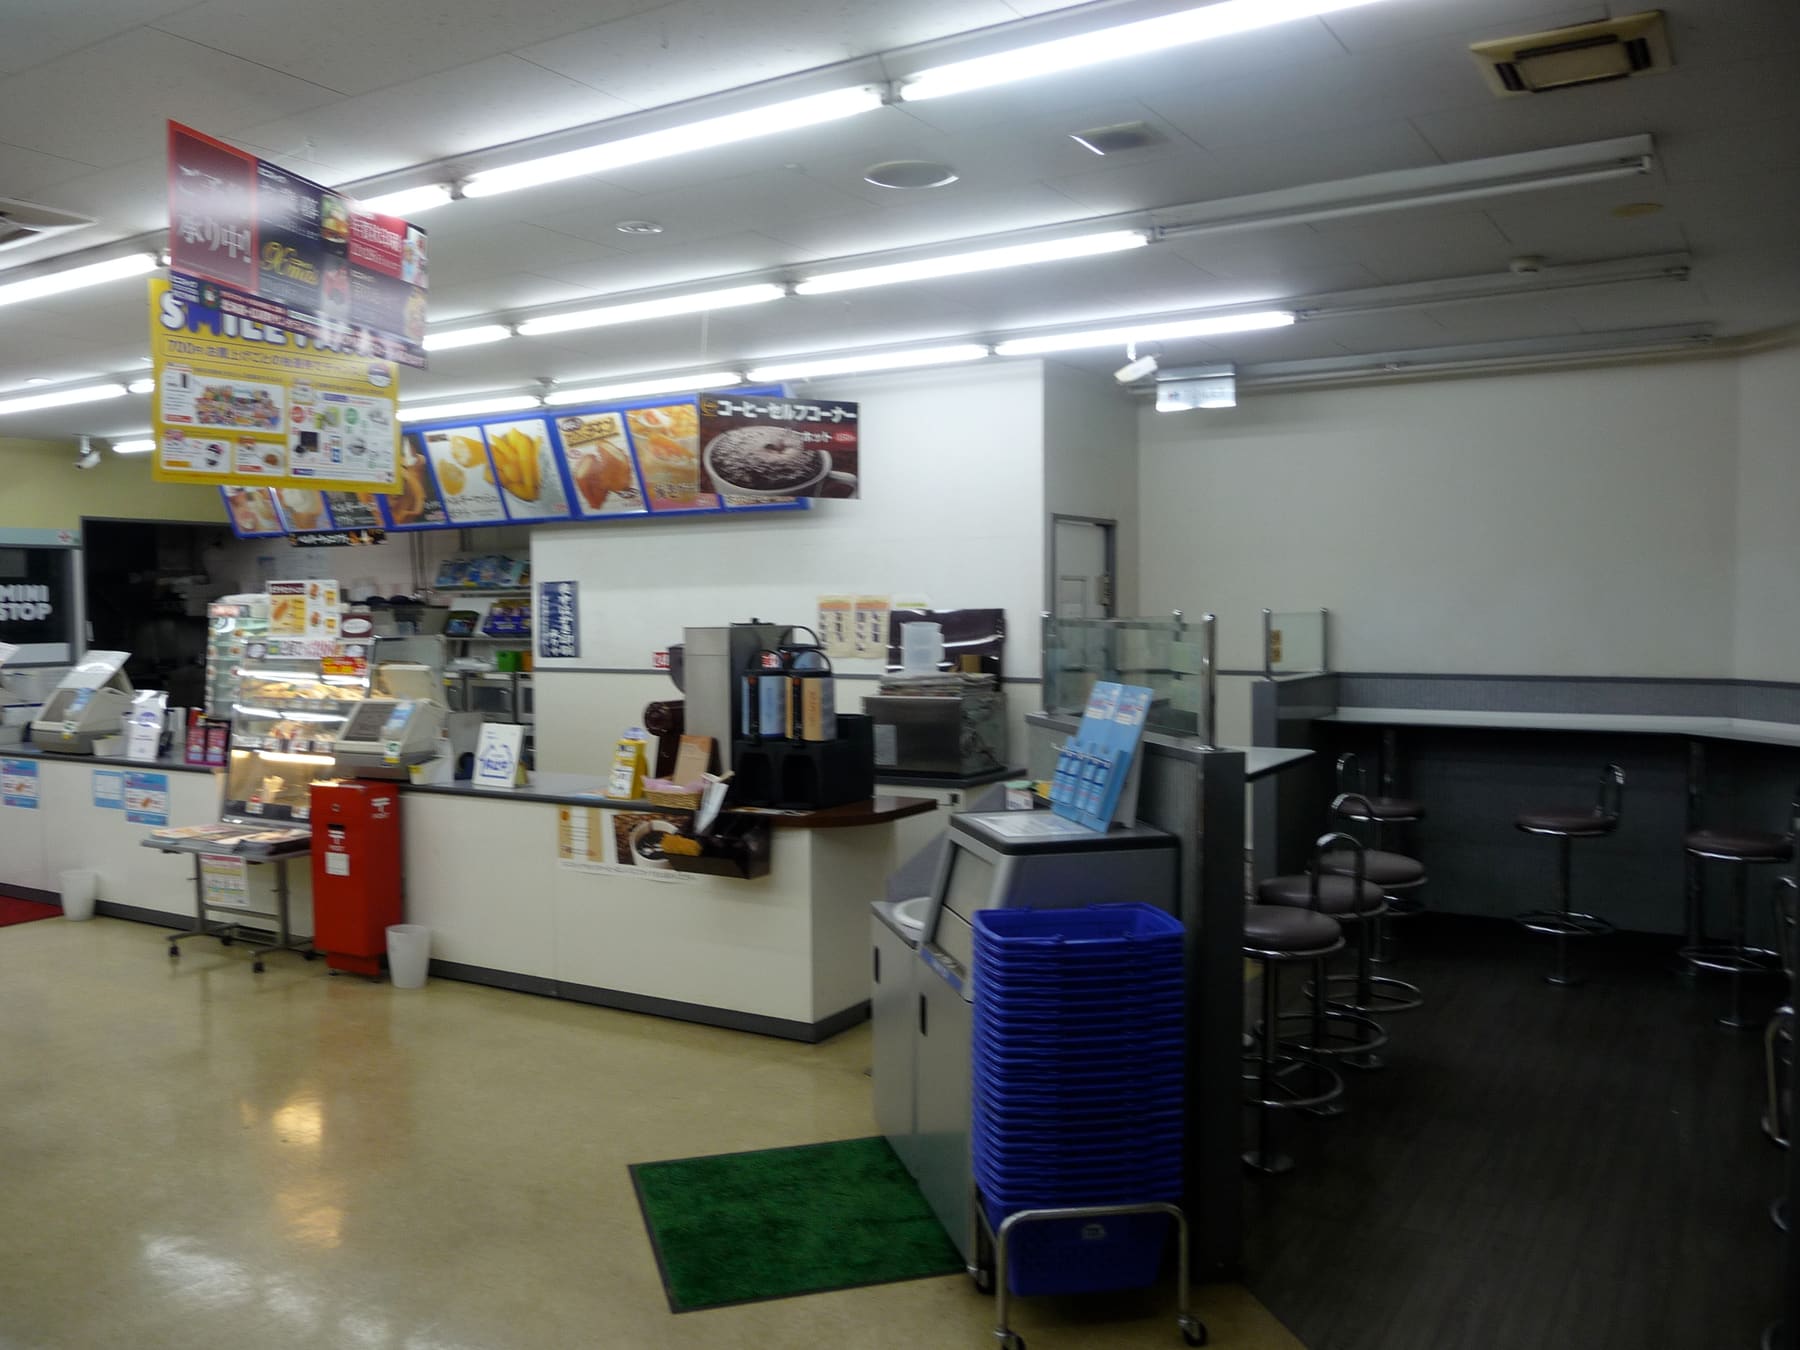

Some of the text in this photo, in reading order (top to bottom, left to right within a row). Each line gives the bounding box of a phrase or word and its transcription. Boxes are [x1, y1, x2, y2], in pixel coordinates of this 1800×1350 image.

[716, 400, 858, 423] コーヒーセルフコーナー
